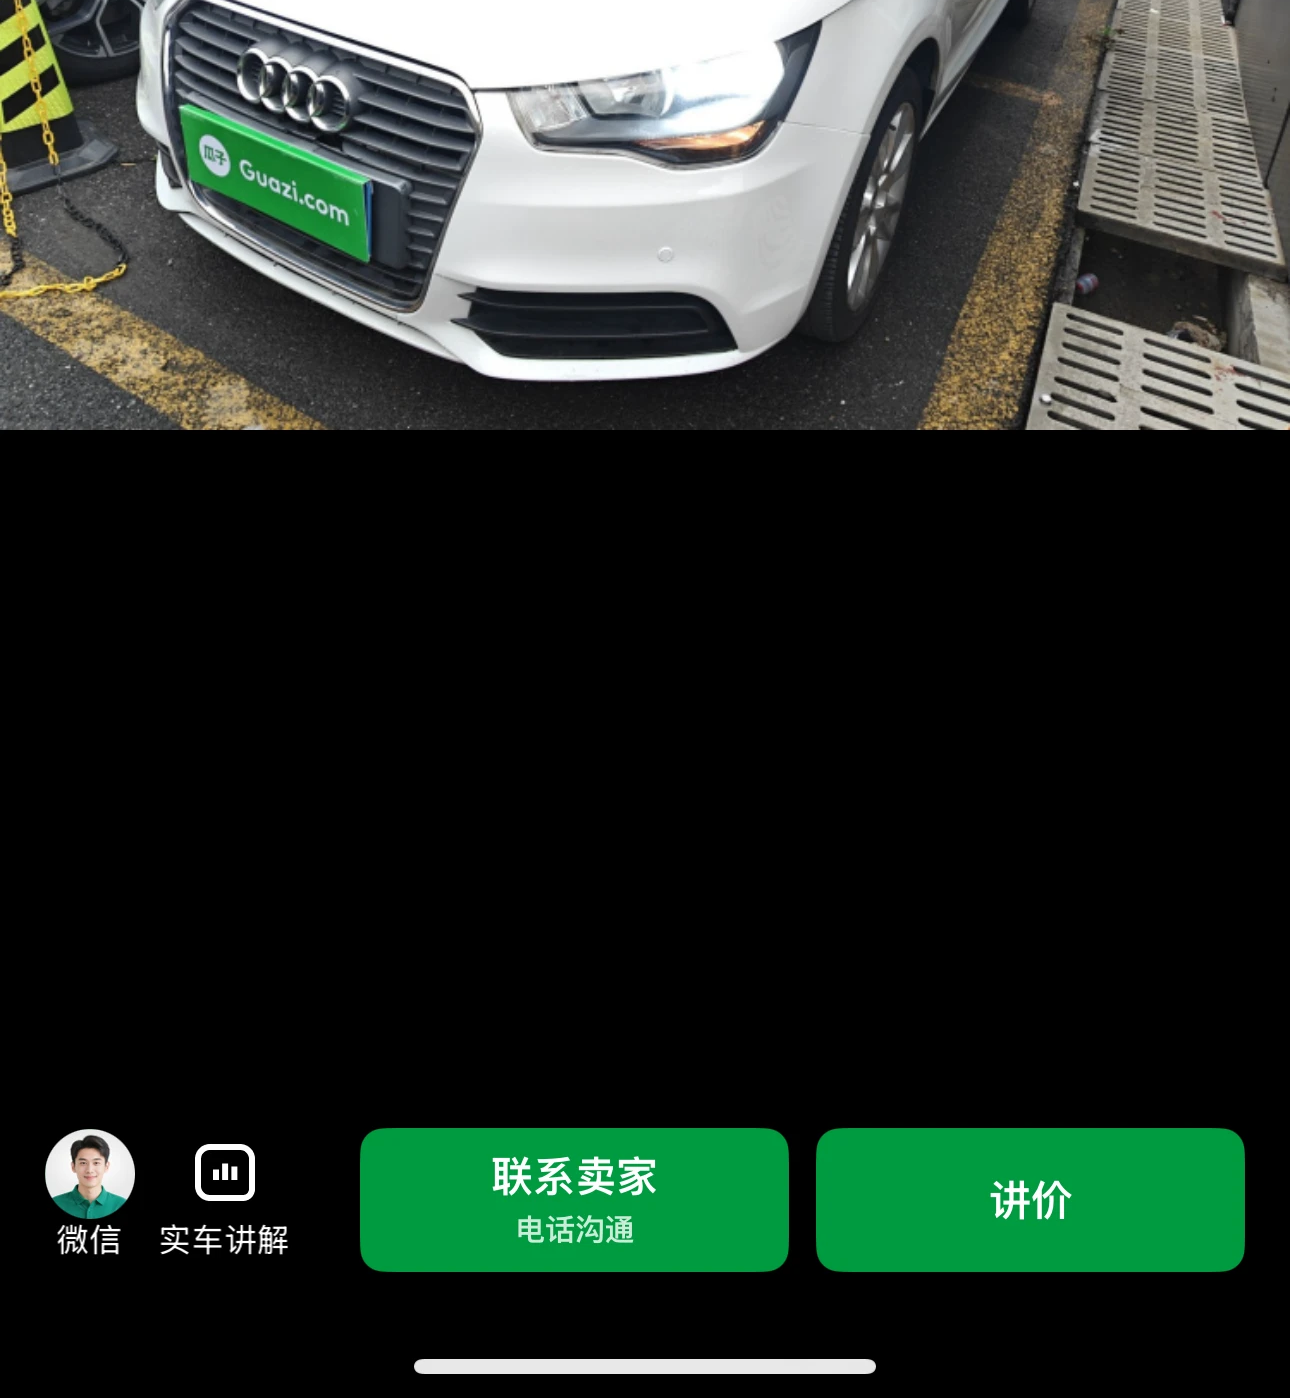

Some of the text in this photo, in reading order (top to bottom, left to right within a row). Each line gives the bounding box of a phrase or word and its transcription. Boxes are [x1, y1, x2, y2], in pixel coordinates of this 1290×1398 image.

[204, 144, 228, 166] 瓜子
[239, 159, 350, 226] Guazi.com
[492, 1155, 657, 1196] 联系卖家
[990, 1180, 1072, 1220] 讲价
[57, 1224, 122, 1255] 微信
[160, 1223, 289, 1256] 实车讲解
[517, 1214, 634, 1244] 电话沟通
